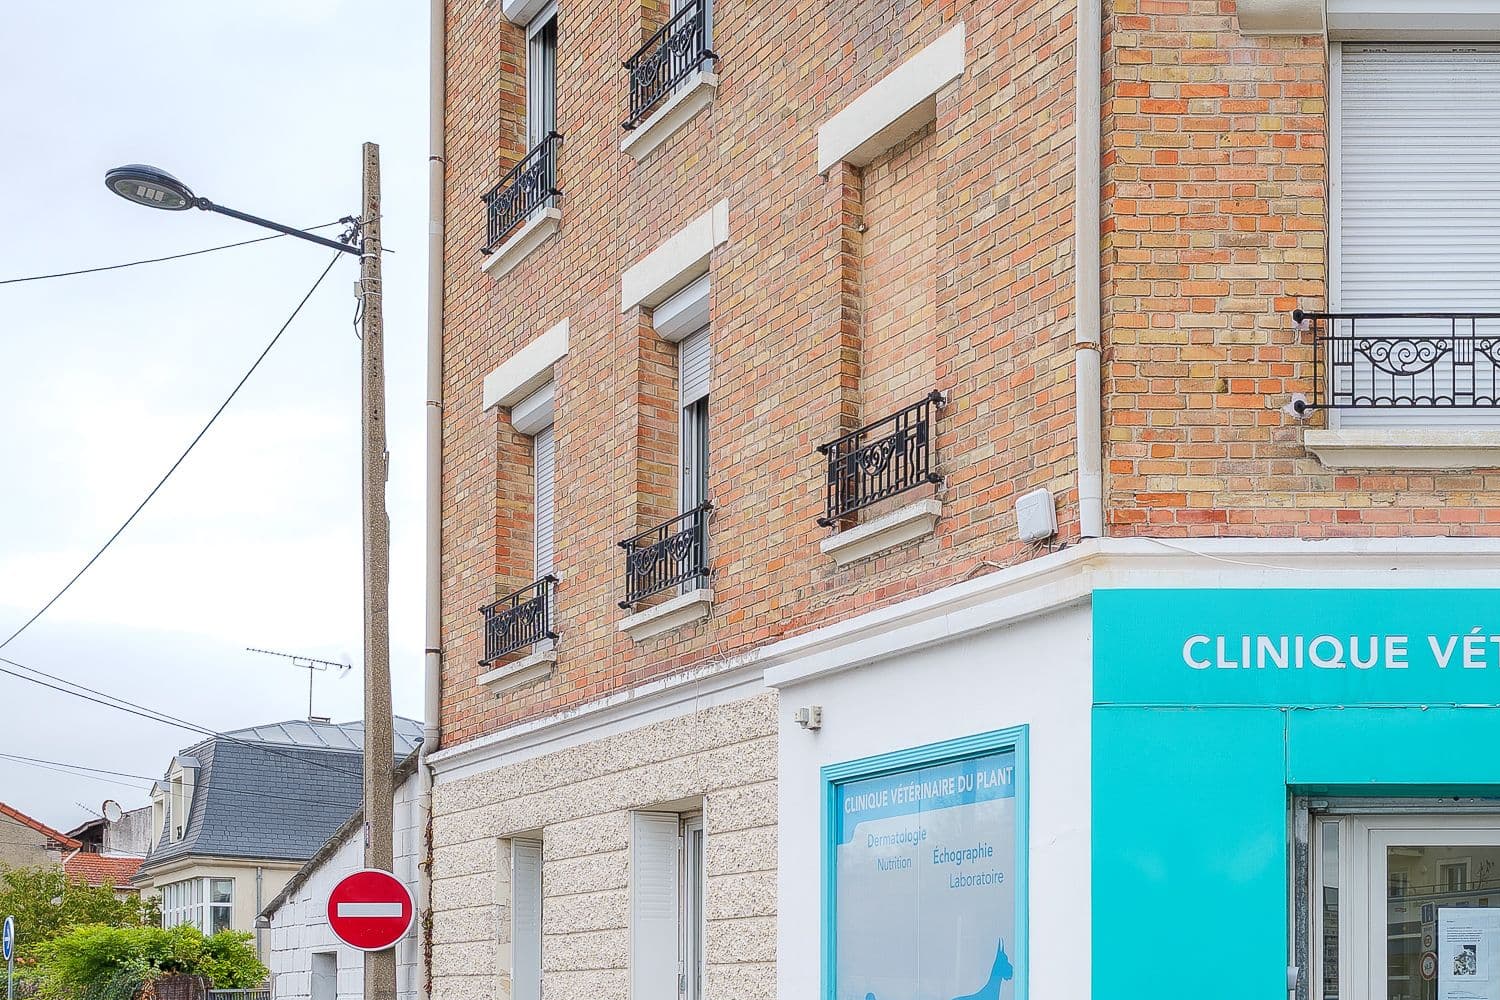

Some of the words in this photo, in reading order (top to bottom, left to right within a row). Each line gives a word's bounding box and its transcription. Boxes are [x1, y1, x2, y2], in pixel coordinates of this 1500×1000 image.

[1182, 634, 1409, 670] CLINIQUE
[844, 790, 888, 814] CLINIQUE
[890, 777, 955, 804] VÉTÉRINAIRE
[957, 774, 974, 792] DU
[976, 766, 1013, 790] PLANT
[867, 826, 927, 849] Dermatologie
[877, 855, 912, 872] Nutrition
[933, 843, 993, 866] Échographie
[949, 869, 1004, 889] Laboratoire
